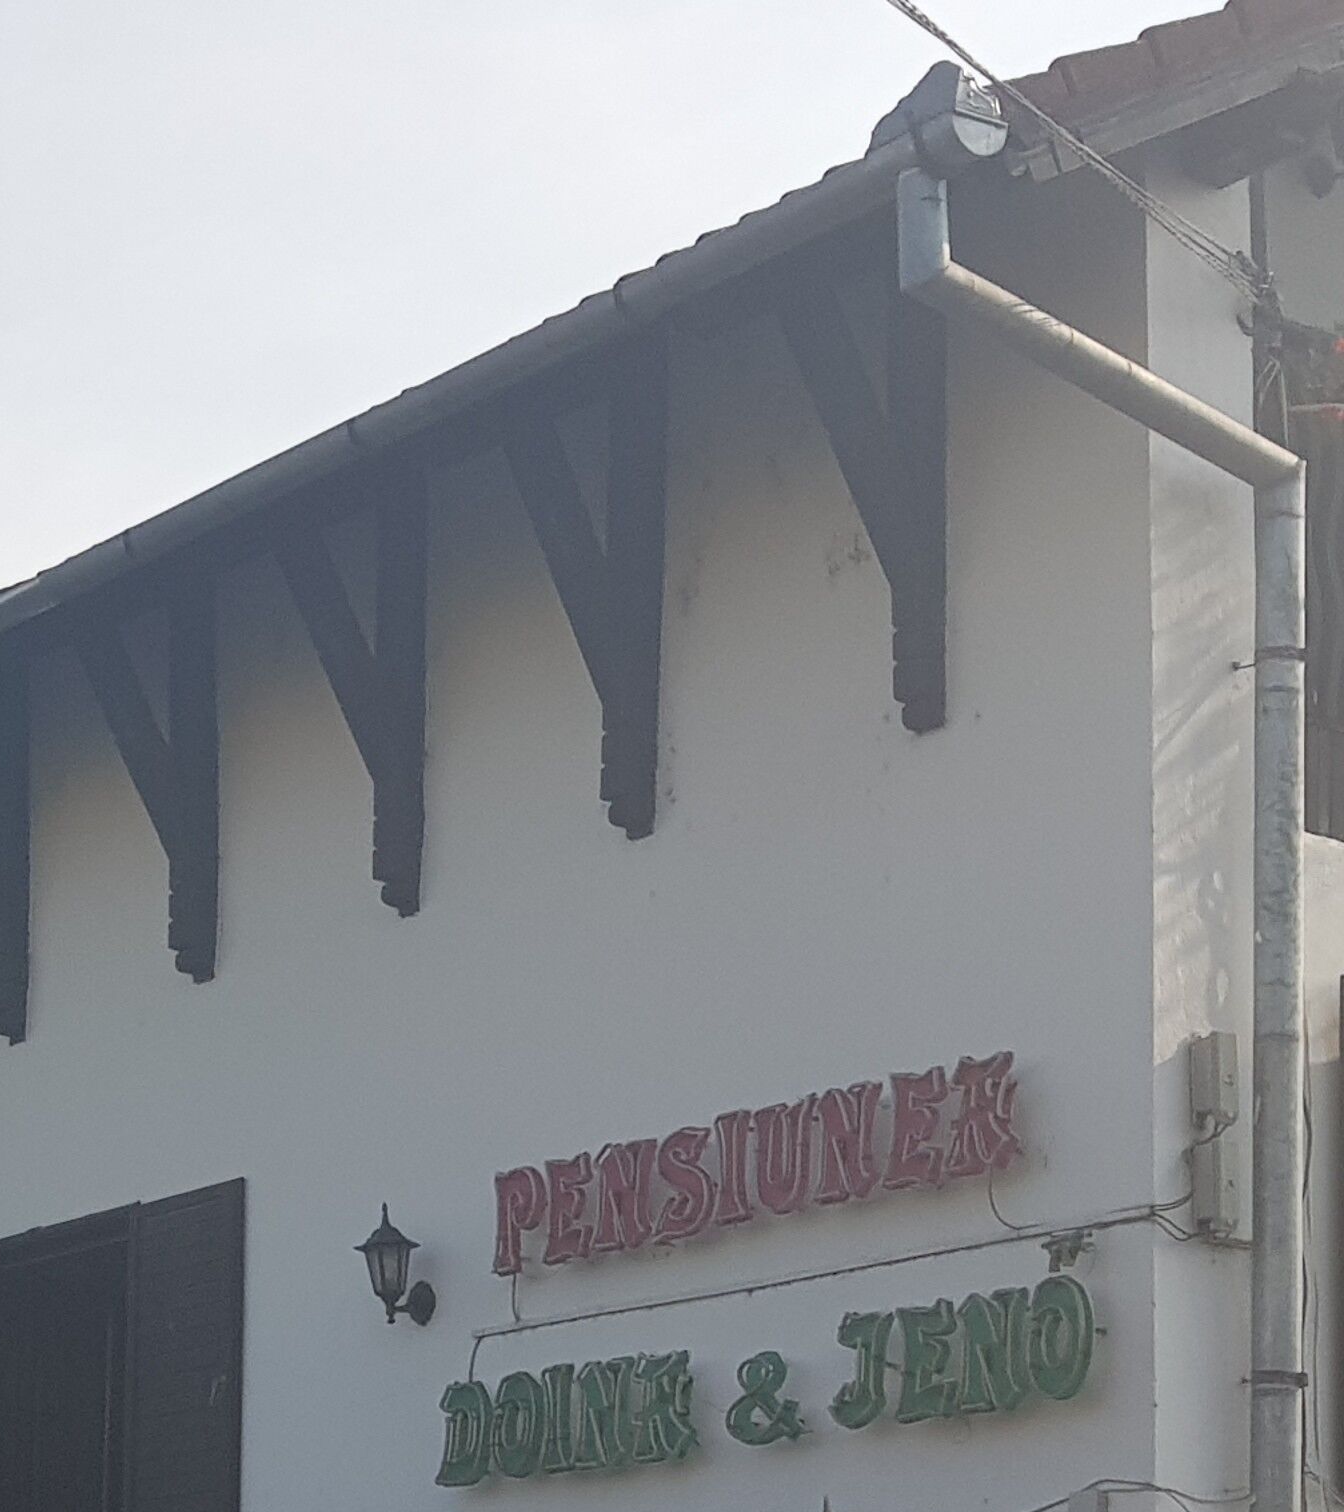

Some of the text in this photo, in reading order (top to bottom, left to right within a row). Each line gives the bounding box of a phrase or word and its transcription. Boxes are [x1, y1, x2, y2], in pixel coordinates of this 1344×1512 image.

[493, 1051, 1021, 1274] PENSIUNEA
[435, 1350, 700, 1487] DOINA
[725, 1350, 812, 1446] &
